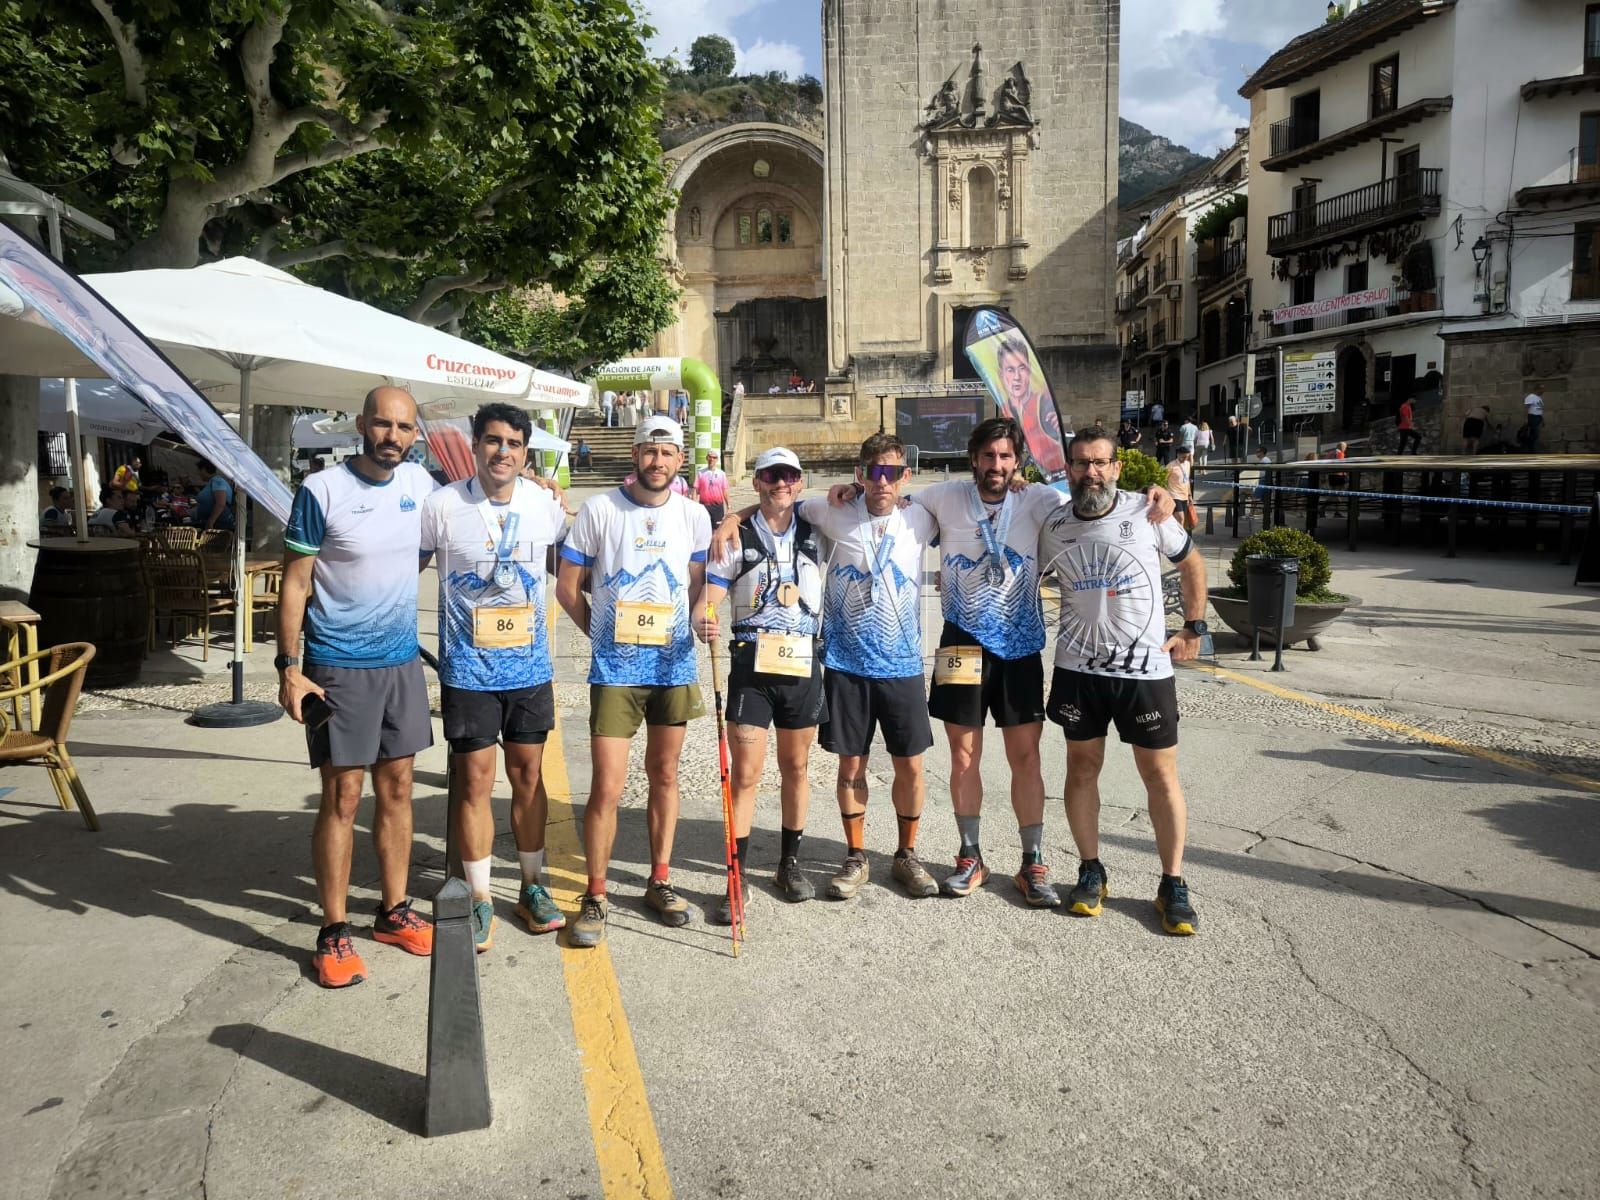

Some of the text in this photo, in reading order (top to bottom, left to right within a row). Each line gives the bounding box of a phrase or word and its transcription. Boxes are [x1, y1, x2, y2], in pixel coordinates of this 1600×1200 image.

[1321, 295, 1350, 312] CENTRO
[1351, 293, 1362, 305] DE
[426, 353, 517, 380] Cruzcampo
[531, 381, 581, 398] Cruzcampo
[753, 571, 767, 609] SALOMON
[497, 618, 514, 632] 86
[637, 614, 655, 627] 84
[777, 645, 794, 659] 82
[947, 656, 962, 669] 85
[1135, 710, 1162, 724] NERJA
